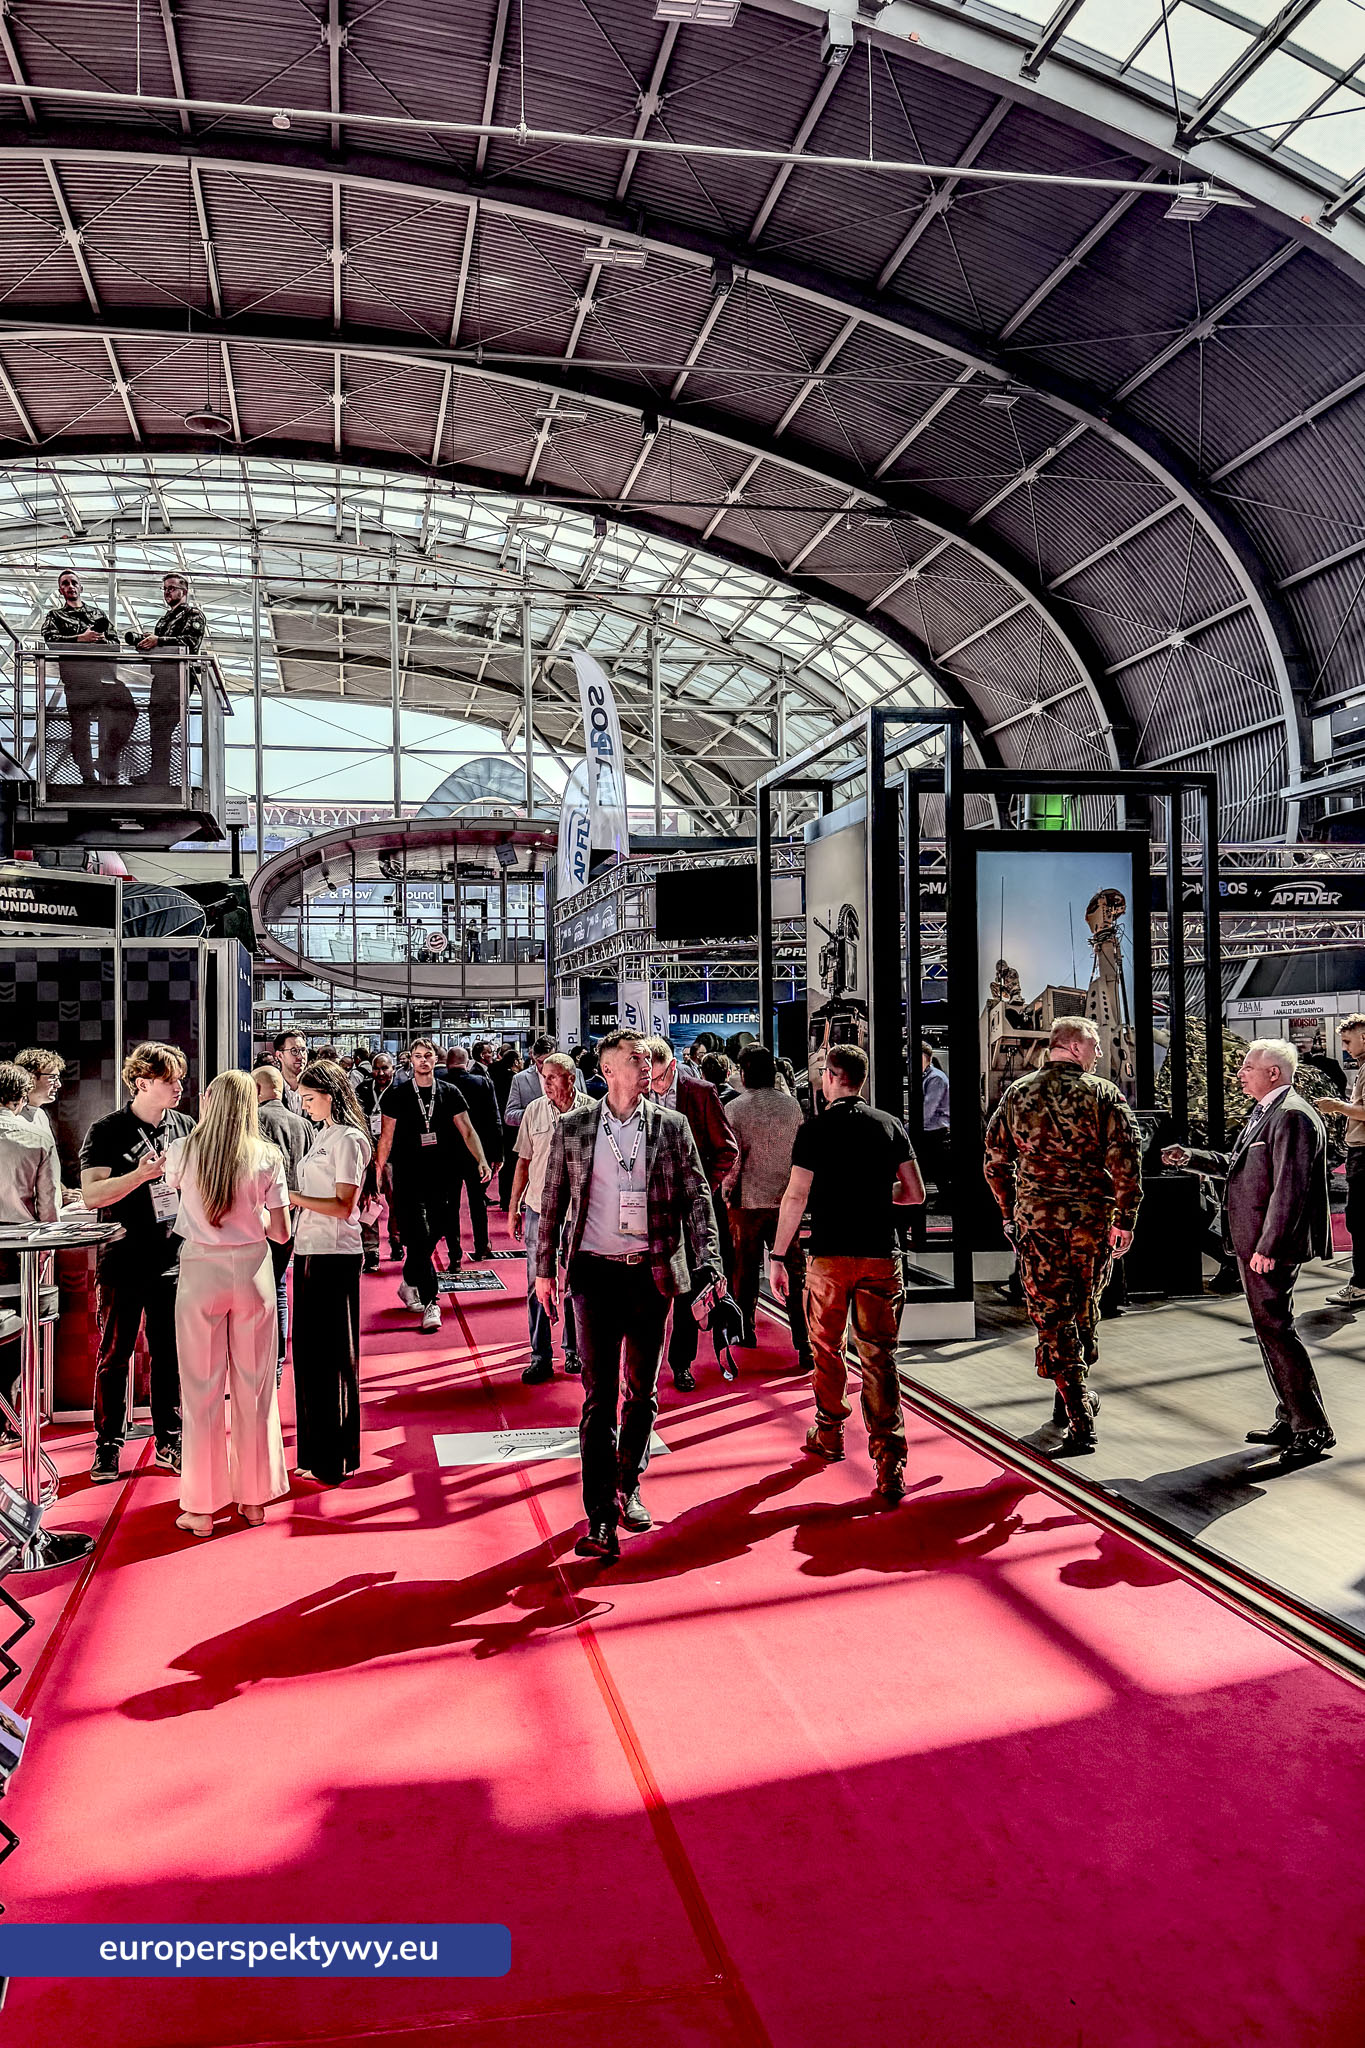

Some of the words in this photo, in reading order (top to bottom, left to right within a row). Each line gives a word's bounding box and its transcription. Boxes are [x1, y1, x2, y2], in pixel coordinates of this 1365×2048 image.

[297, 808, 361, 826] MŁYN
[1271, 893, 1294, 905] AP
[1294, 891, 1342, 905] FLYER
[776, 947, 792, 957] AP
[625, 1002, 636, 1025] AP
[680, 1014, 690, 1024] IN
[692, 1013, 722, 1024] DRONE
[653, 1015, 661, 1031] AP
